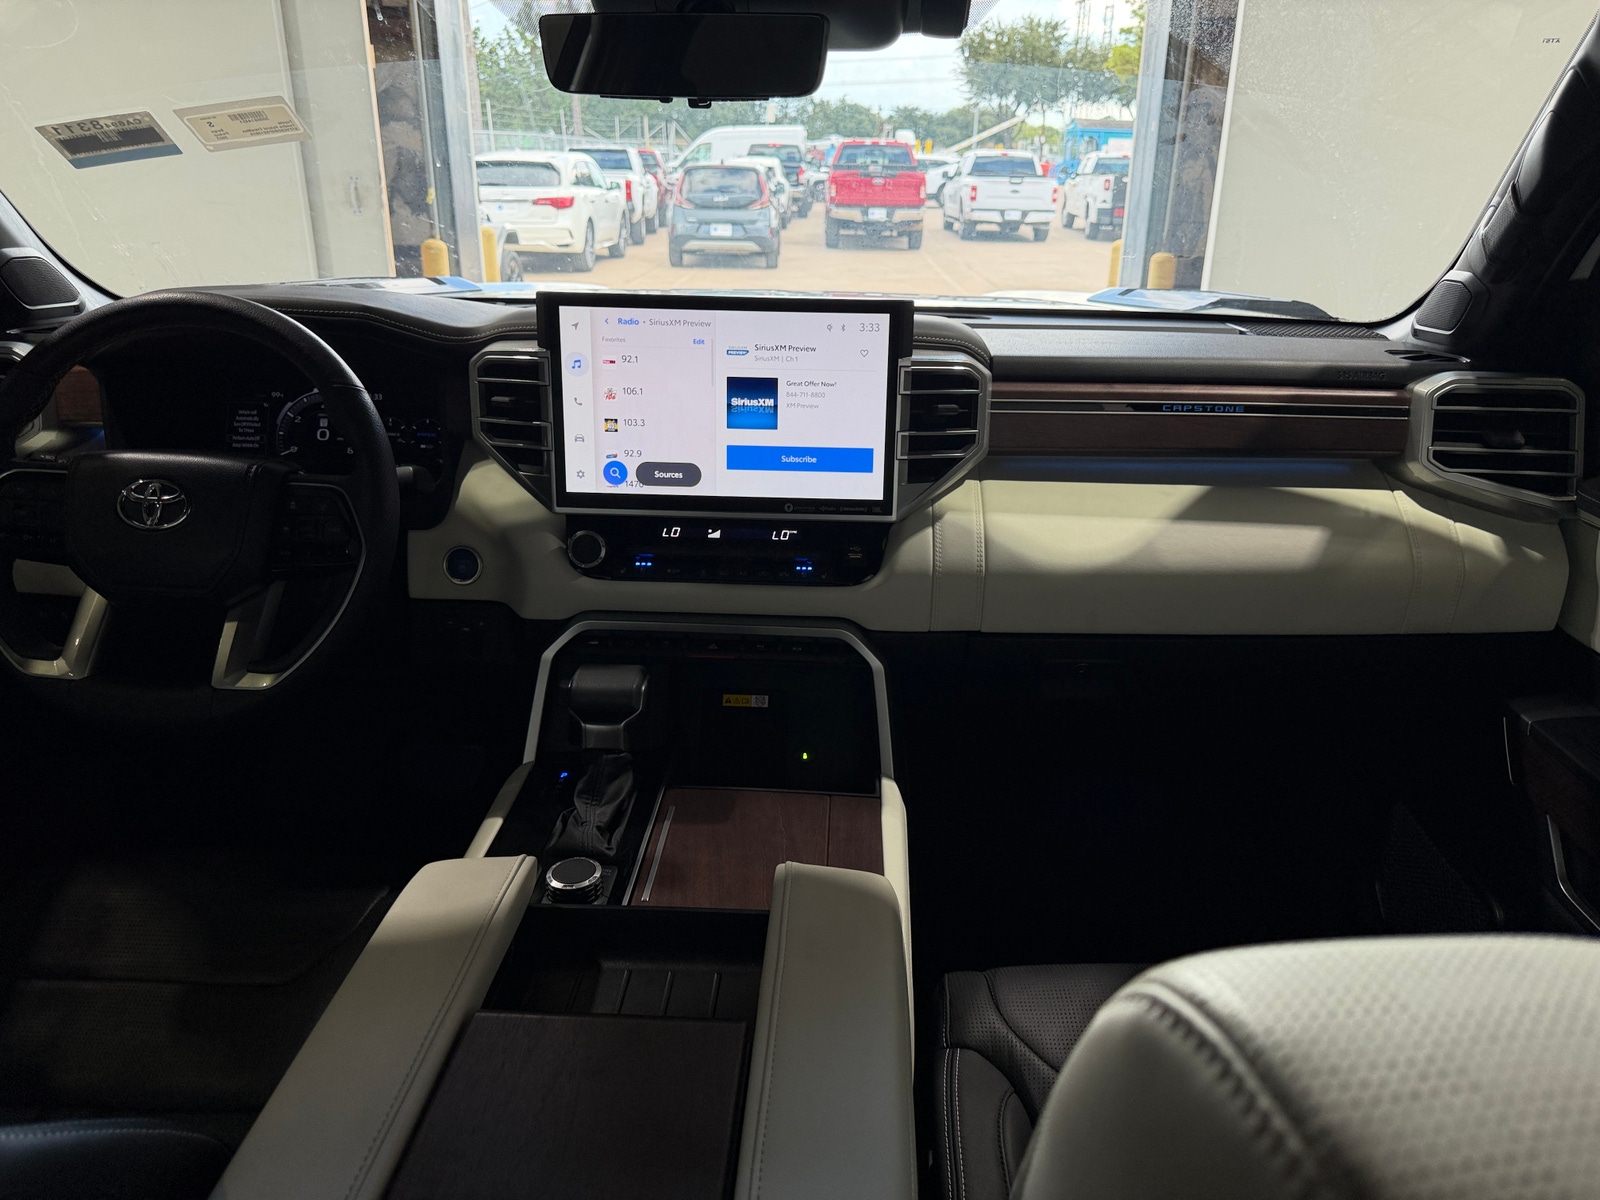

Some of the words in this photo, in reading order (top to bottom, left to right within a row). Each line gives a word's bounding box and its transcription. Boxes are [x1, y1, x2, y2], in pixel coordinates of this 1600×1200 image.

[617, 317, 640, 326] Radio
[648, 318, 682, 327] SiriusXM
[859, 322, 880, 332] 3:33
[754, 344, 787, 352] SiriusXM
[788, 345, 817, 353] Preview
[621, 355, 639, 364] 92.1
[622, 387, 643, 396] 106.1
[786, 391, 826, 399] 844-711-8800
[730, 398, 774, 407] SiriusXM
[1162, 404, 1245, 413] CAPSTONE
[623, 418, 646, 427] 103.3
[623, 449, 642, 458] 92.9
[781, 454, 817, 464] Subscribe
[654, 470, 683, 479] Sources
